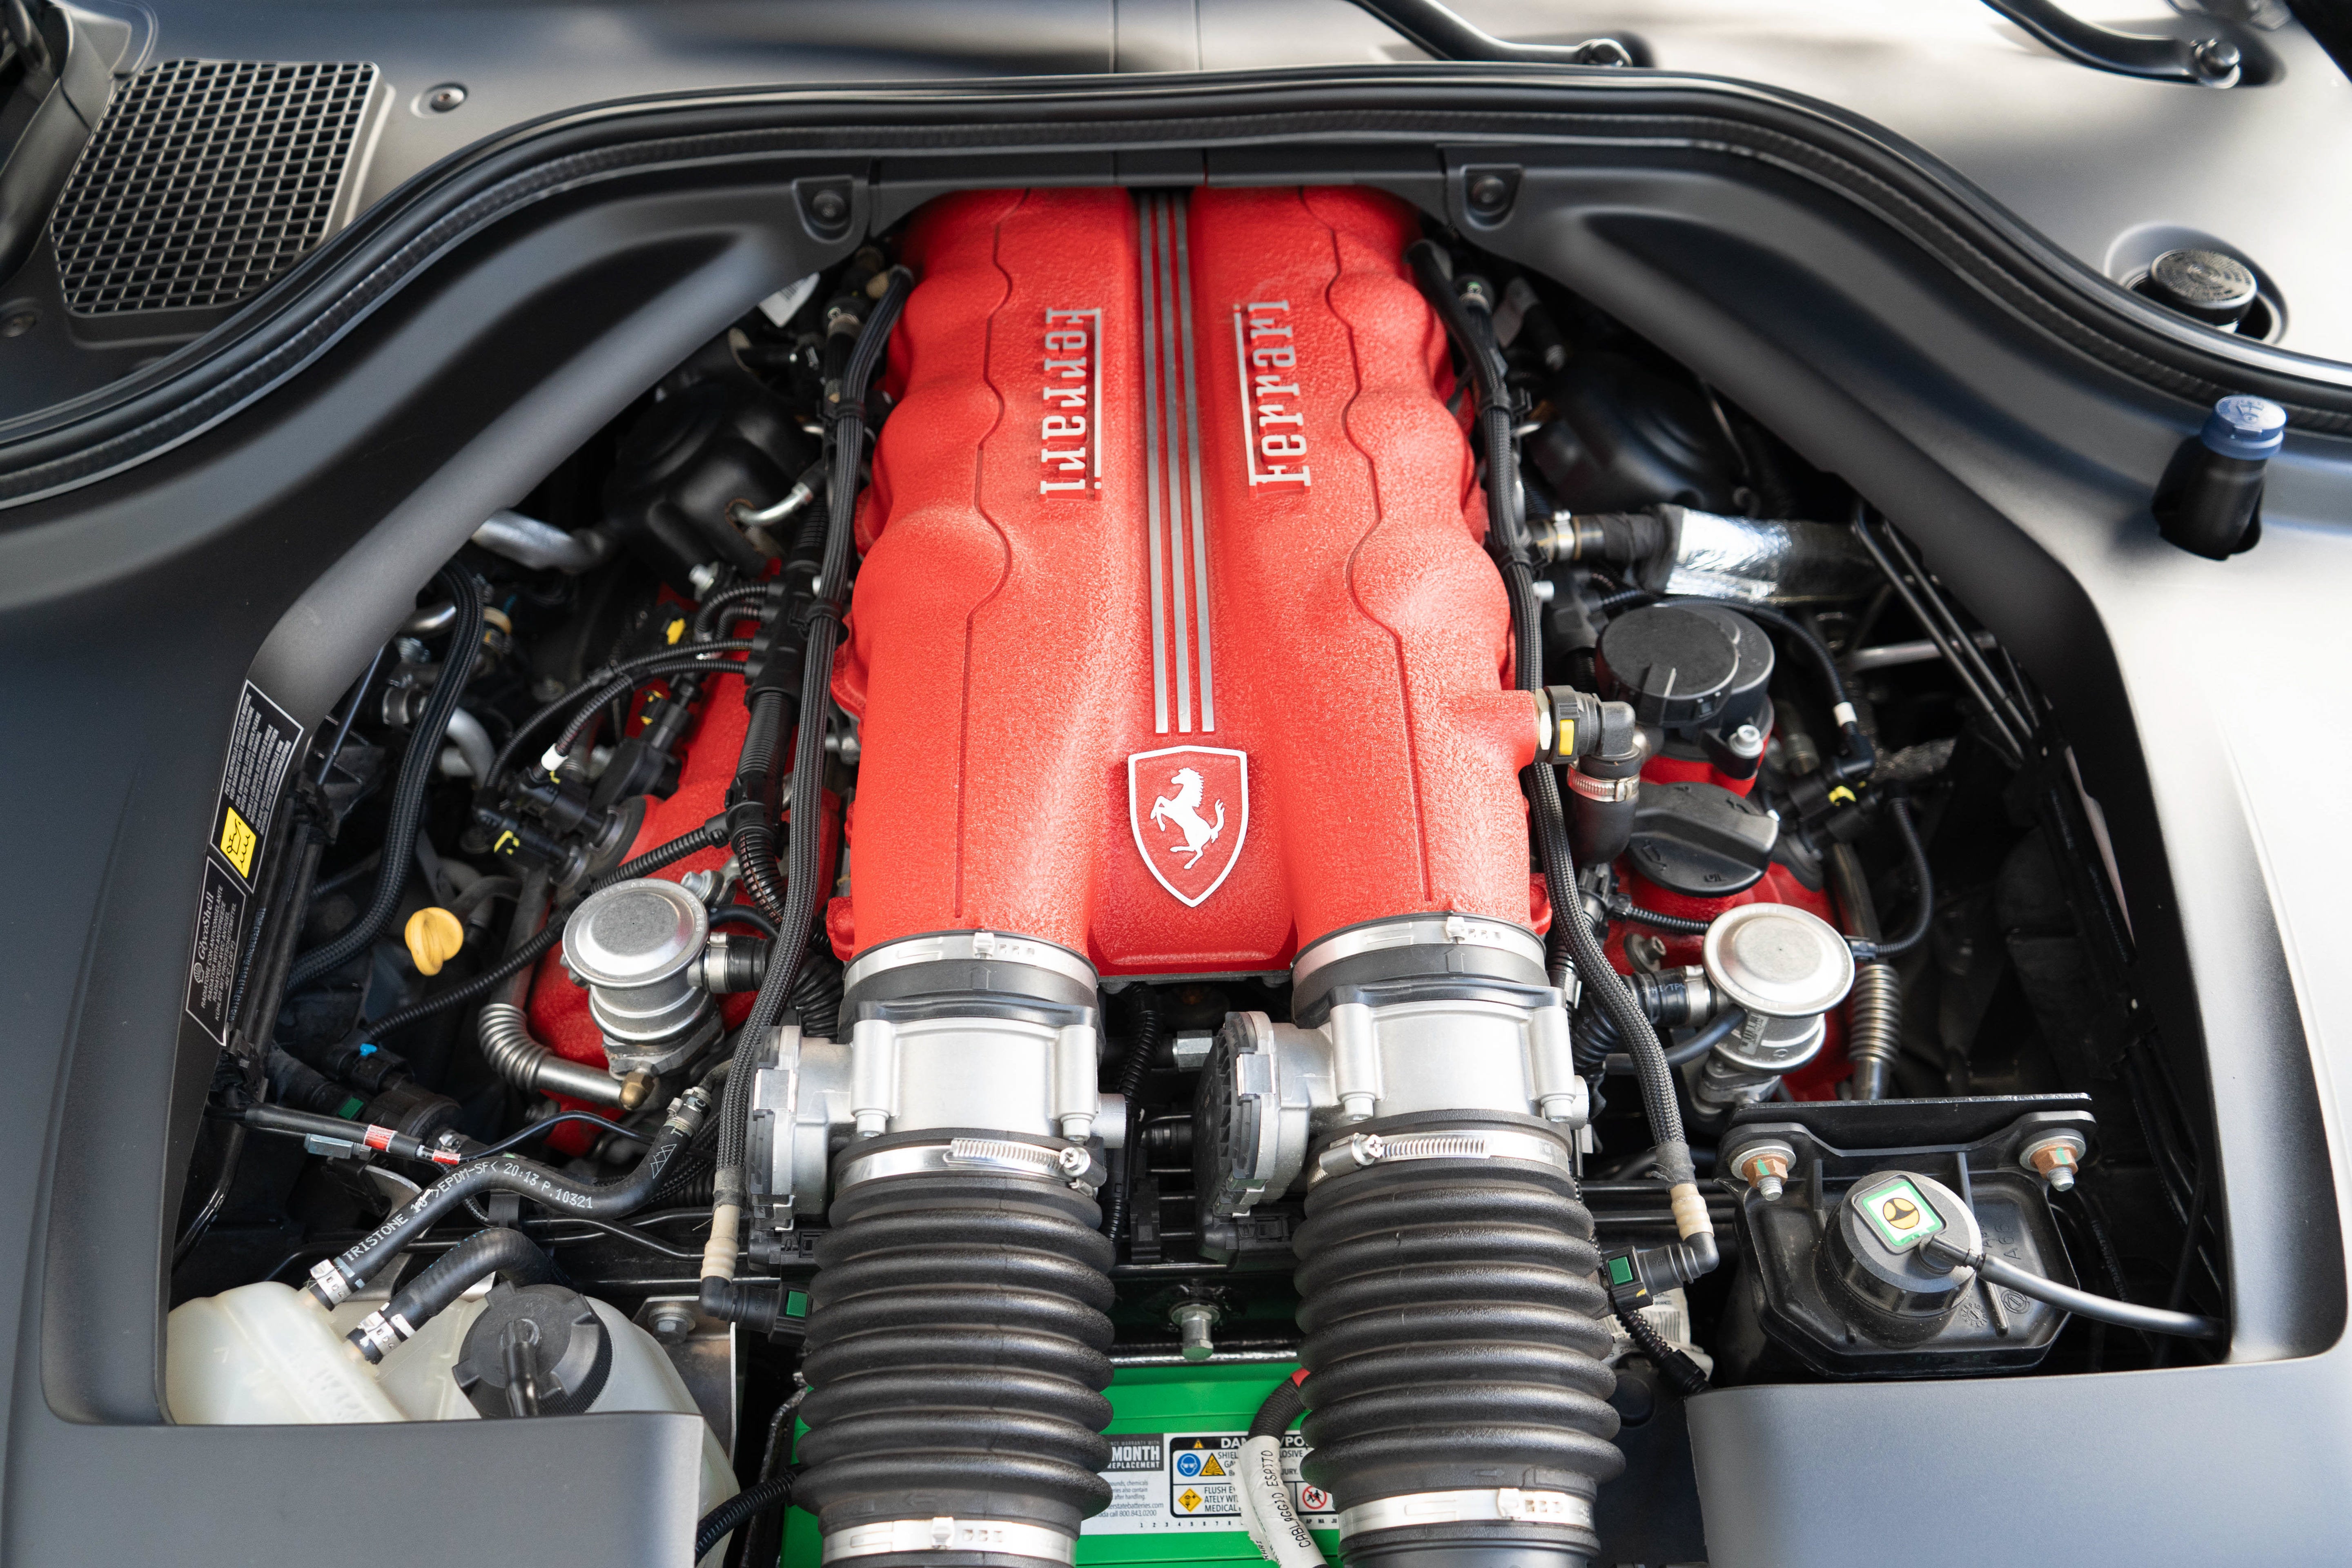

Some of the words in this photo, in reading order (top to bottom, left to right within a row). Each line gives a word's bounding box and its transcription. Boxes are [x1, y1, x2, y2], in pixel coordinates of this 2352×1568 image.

[1040, 307, 1102, 494] Ferrari
[1234, 301, 1311, 486] Ferrari
[198, 891, 214, 960] GlycoShell
[201, 965, 210, 1008] RADIATORE
[209, 884, 223, 949] ANTICONGELANTE
[207, 963, 216, 1001] RADIATOR
[216, 900, 225, 944] ANTIFREEZE
[212, 960, 222, 1002] RADIATEUR
[221, 911, 229, 940] ANTIGEL
[343, 1213, 409, 1261] TRISTONE
[503, 1163, 540, 1186] 20:13
[541, 1181, 593, 1209] P.10321
[1111, 1446, 1160, 1461] MONTH
[1204, 1495, 1225, 1503] ATELY
[1205, 1504, 1237, 1512] MEDICAL
